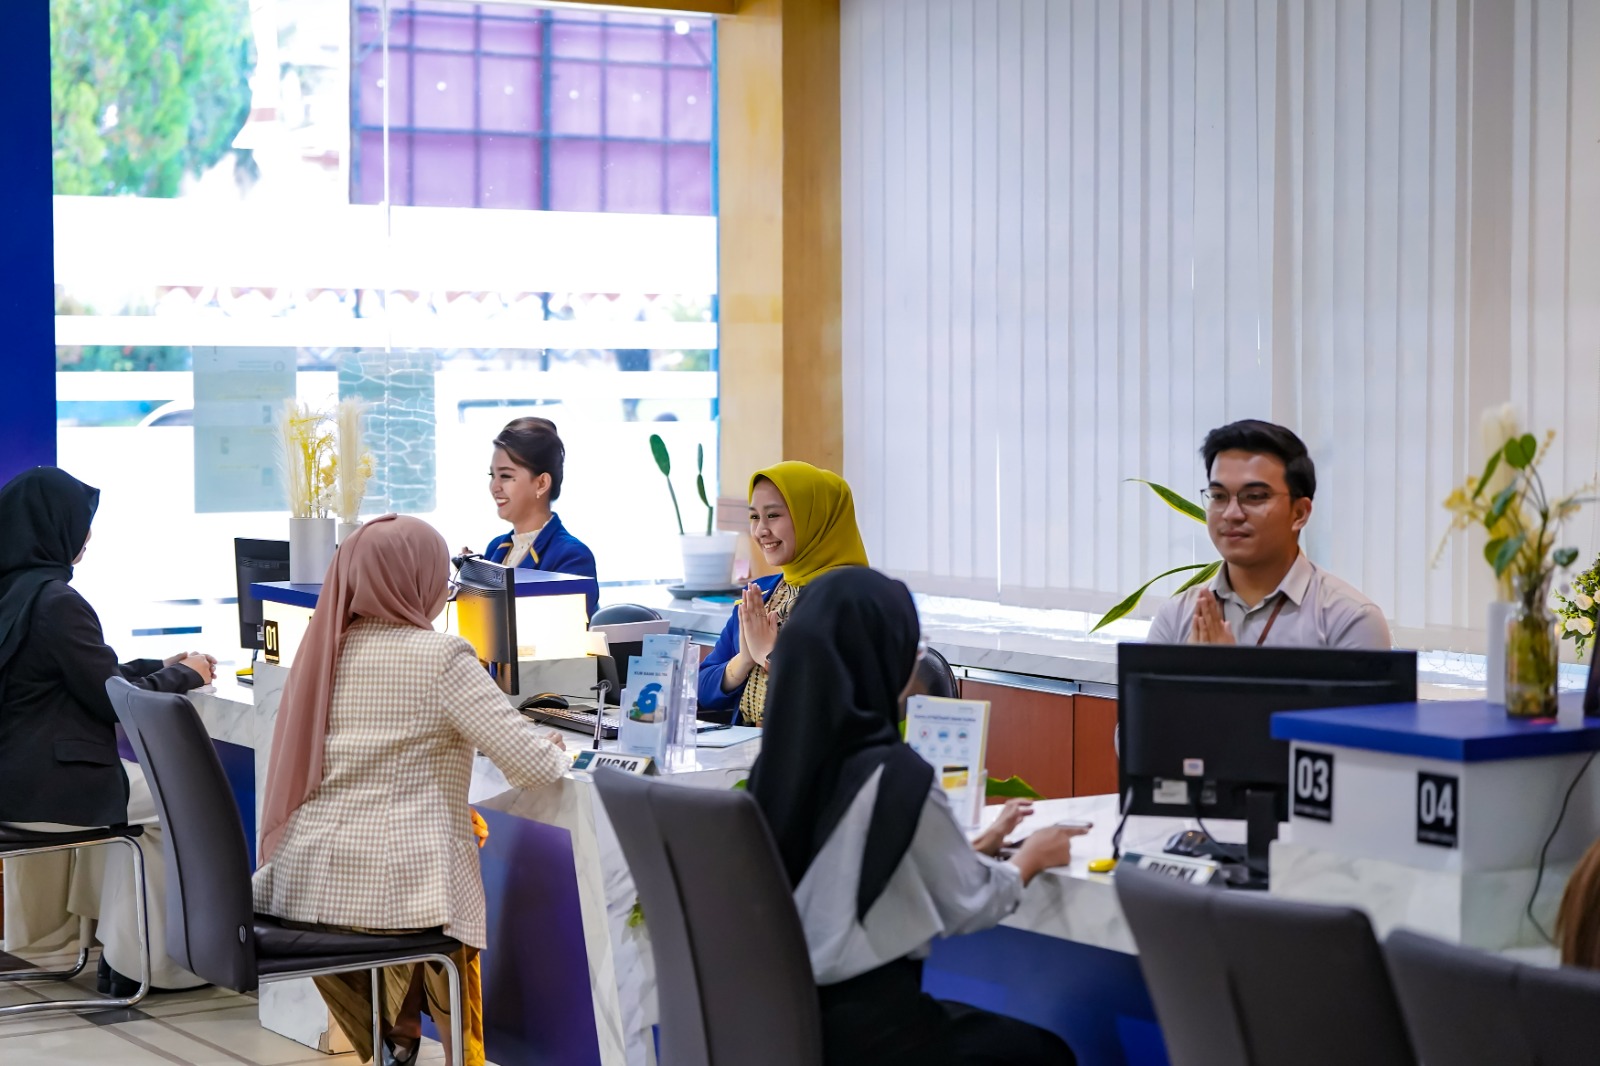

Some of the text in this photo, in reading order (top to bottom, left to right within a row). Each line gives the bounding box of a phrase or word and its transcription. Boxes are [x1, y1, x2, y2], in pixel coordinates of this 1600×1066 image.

[265, 625, 277, 651] 01
[637, 682, 663, 714] 6
[1297, 756, 1329, 801] 03
[1420, 780, 1454, 827] 04
